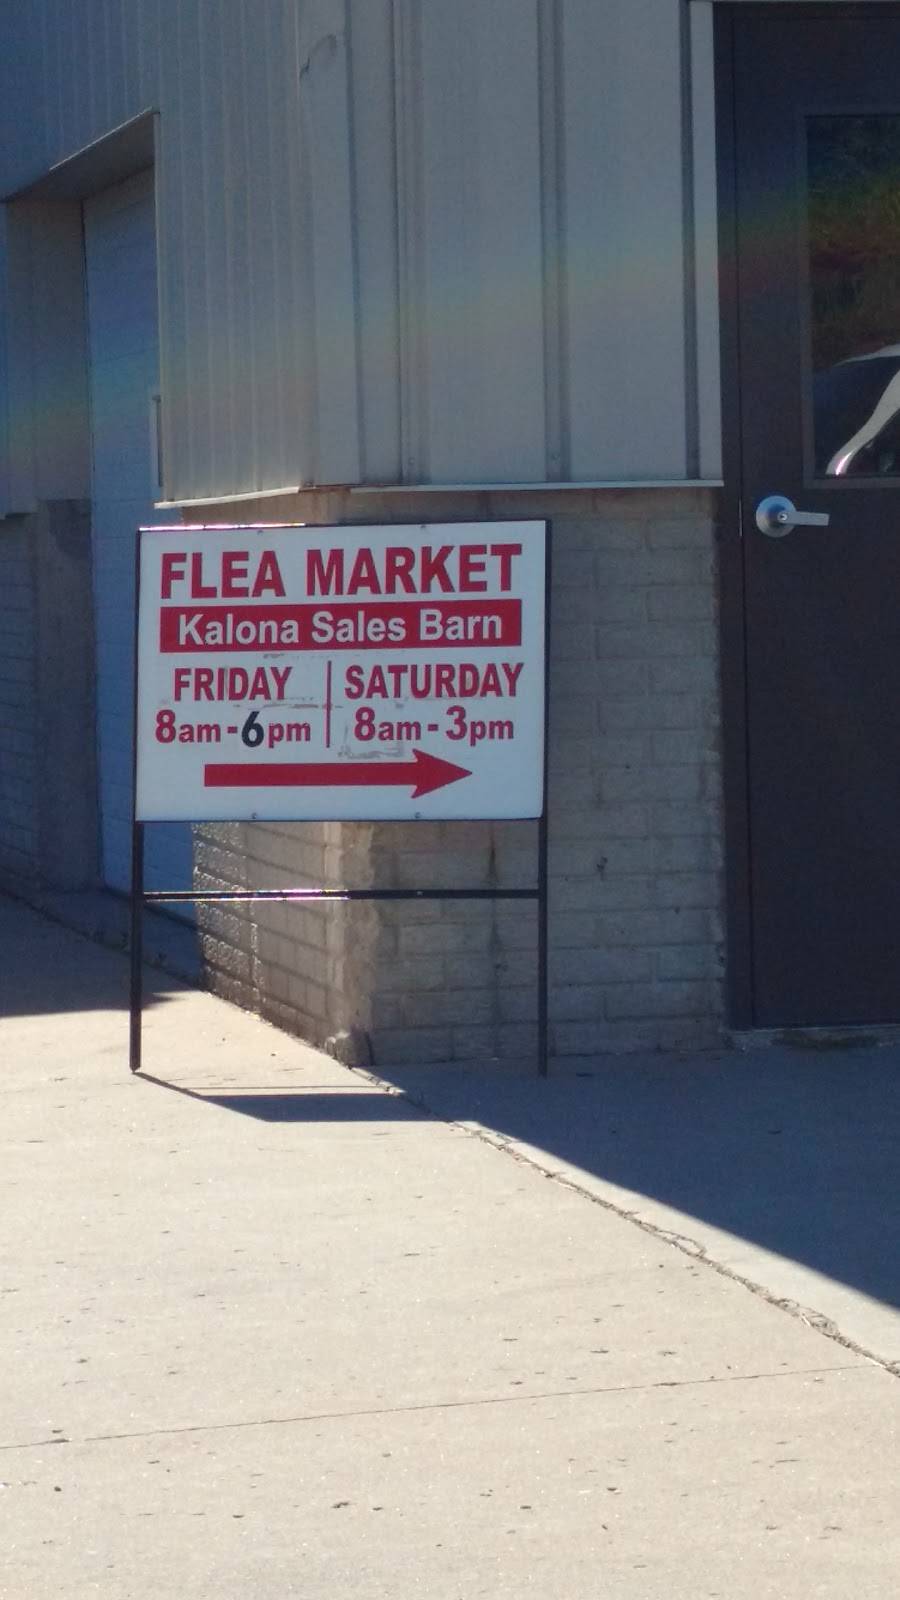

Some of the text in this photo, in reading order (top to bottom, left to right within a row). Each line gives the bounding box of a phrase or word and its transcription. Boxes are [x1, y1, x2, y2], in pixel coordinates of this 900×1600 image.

[161, 544, 522, 599] FLEA MARKET
[178, 609, 502, 645] Kalona Sales Barn
[174, 666, 292, 701] FRIDAY
[344, 663, 524, 699] SATURDAY
